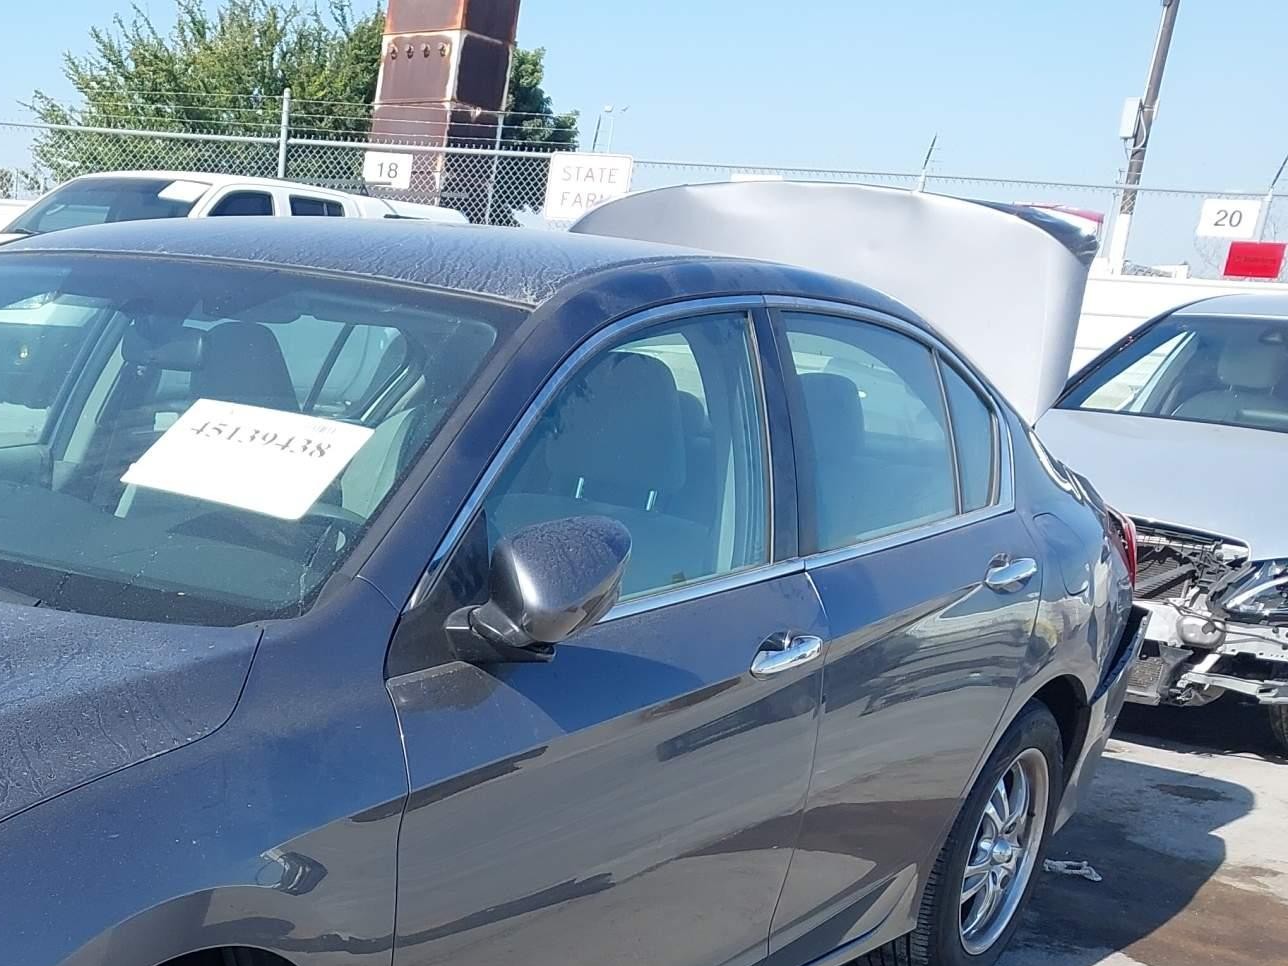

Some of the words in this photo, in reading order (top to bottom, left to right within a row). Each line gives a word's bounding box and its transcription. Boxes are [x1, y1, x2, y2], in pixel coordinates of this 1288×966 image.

[377, 162, 399, 179] 18
[560, 166, 619, 185] STATE
[1213, 209, 1243, 228] 20
[190, 420, 332, 458] 45139438
